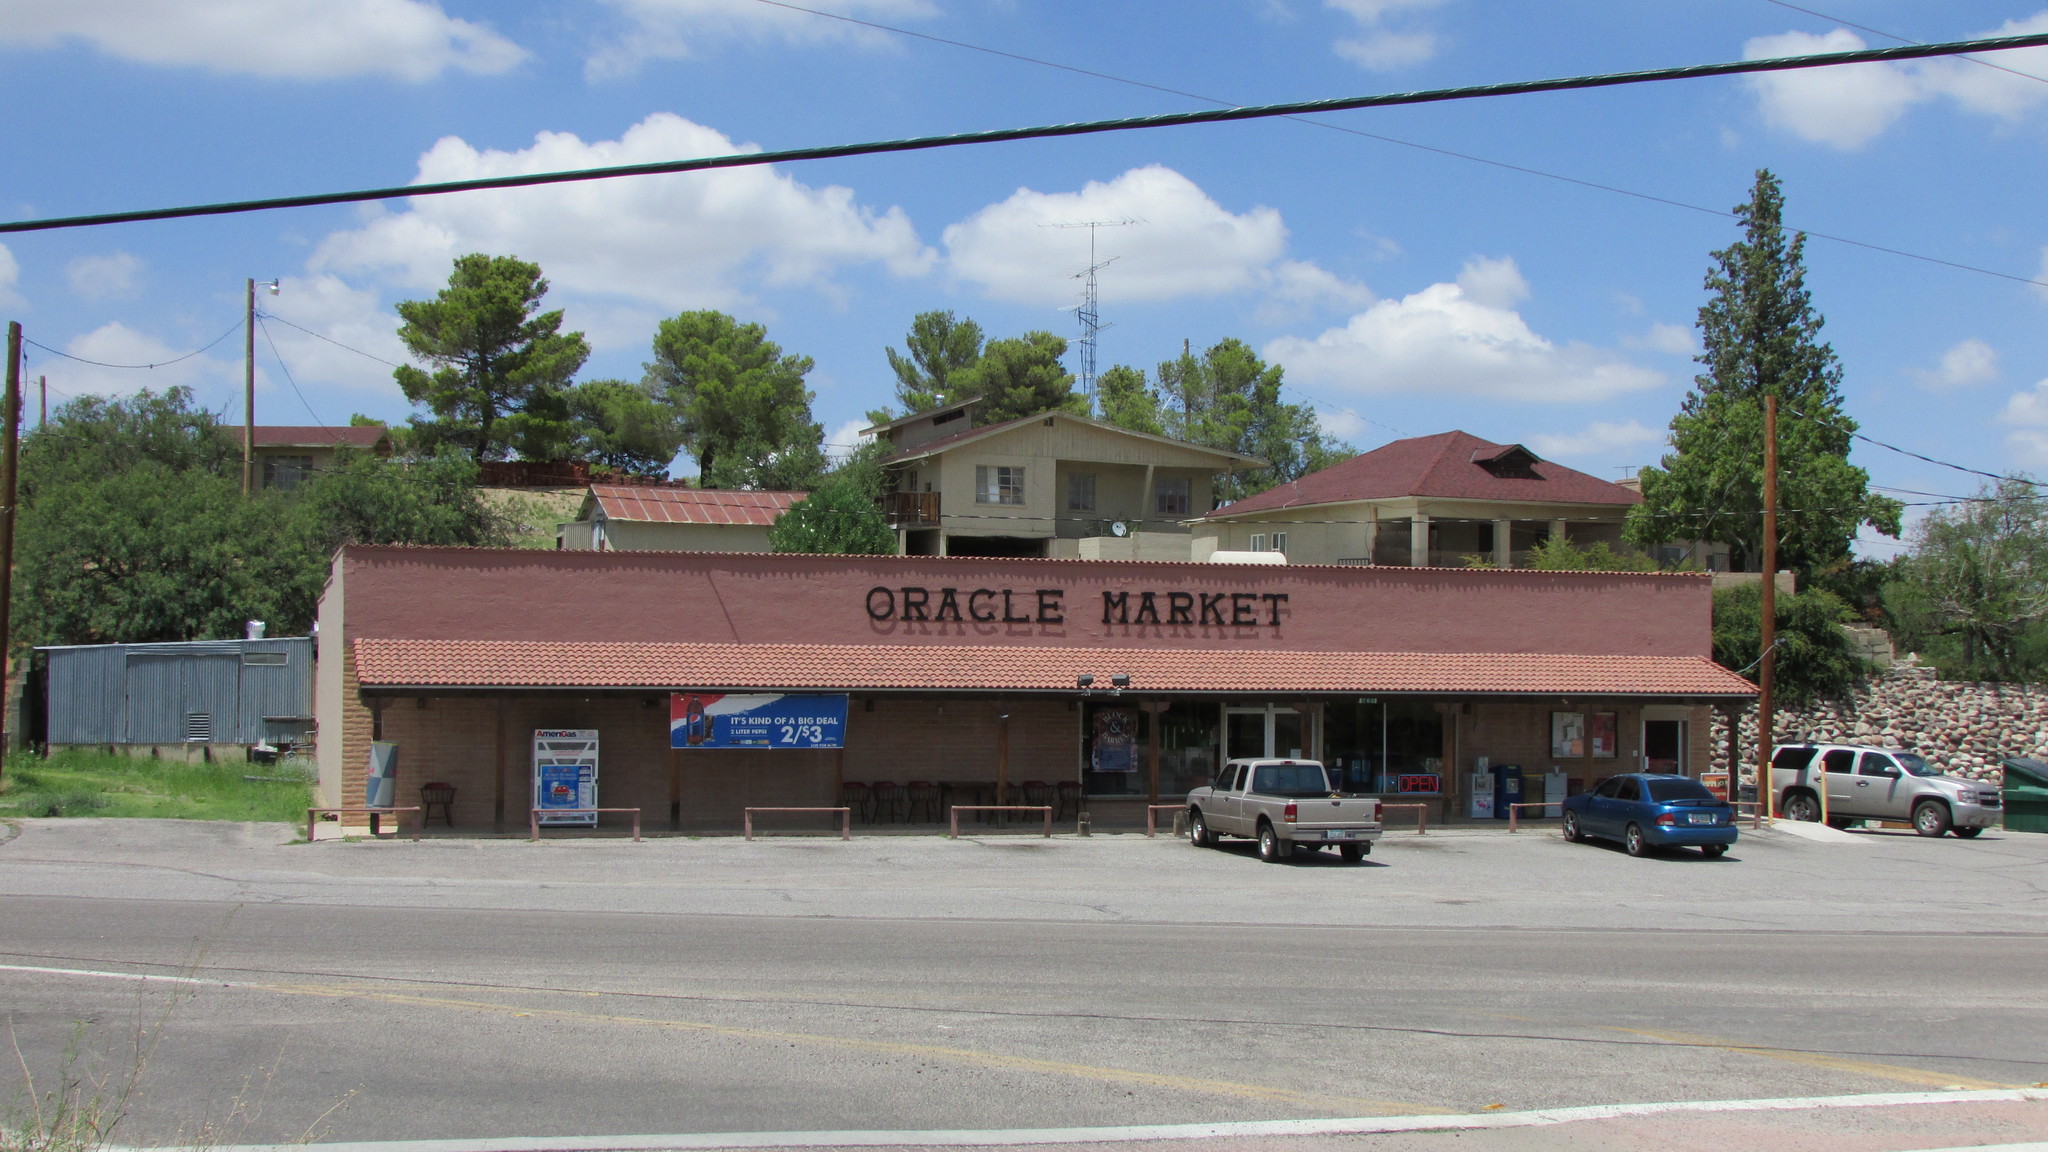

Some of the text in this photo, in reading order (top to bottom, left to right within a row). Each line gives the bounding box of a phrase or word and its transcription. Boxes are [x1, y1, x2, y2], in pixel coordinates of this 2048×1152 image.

[866, 586, 1289, 626] ORACLE MARKET
[731, 717, 838, 725] IT'S KIND OF A BIG DEAL
[1102, 711, 1129, 724] BLOCK
[1110, 720, 1121, 733] &
[781, 725, 823, 745] 2/$3
[1400, 775, 1439, 792] OPEN
